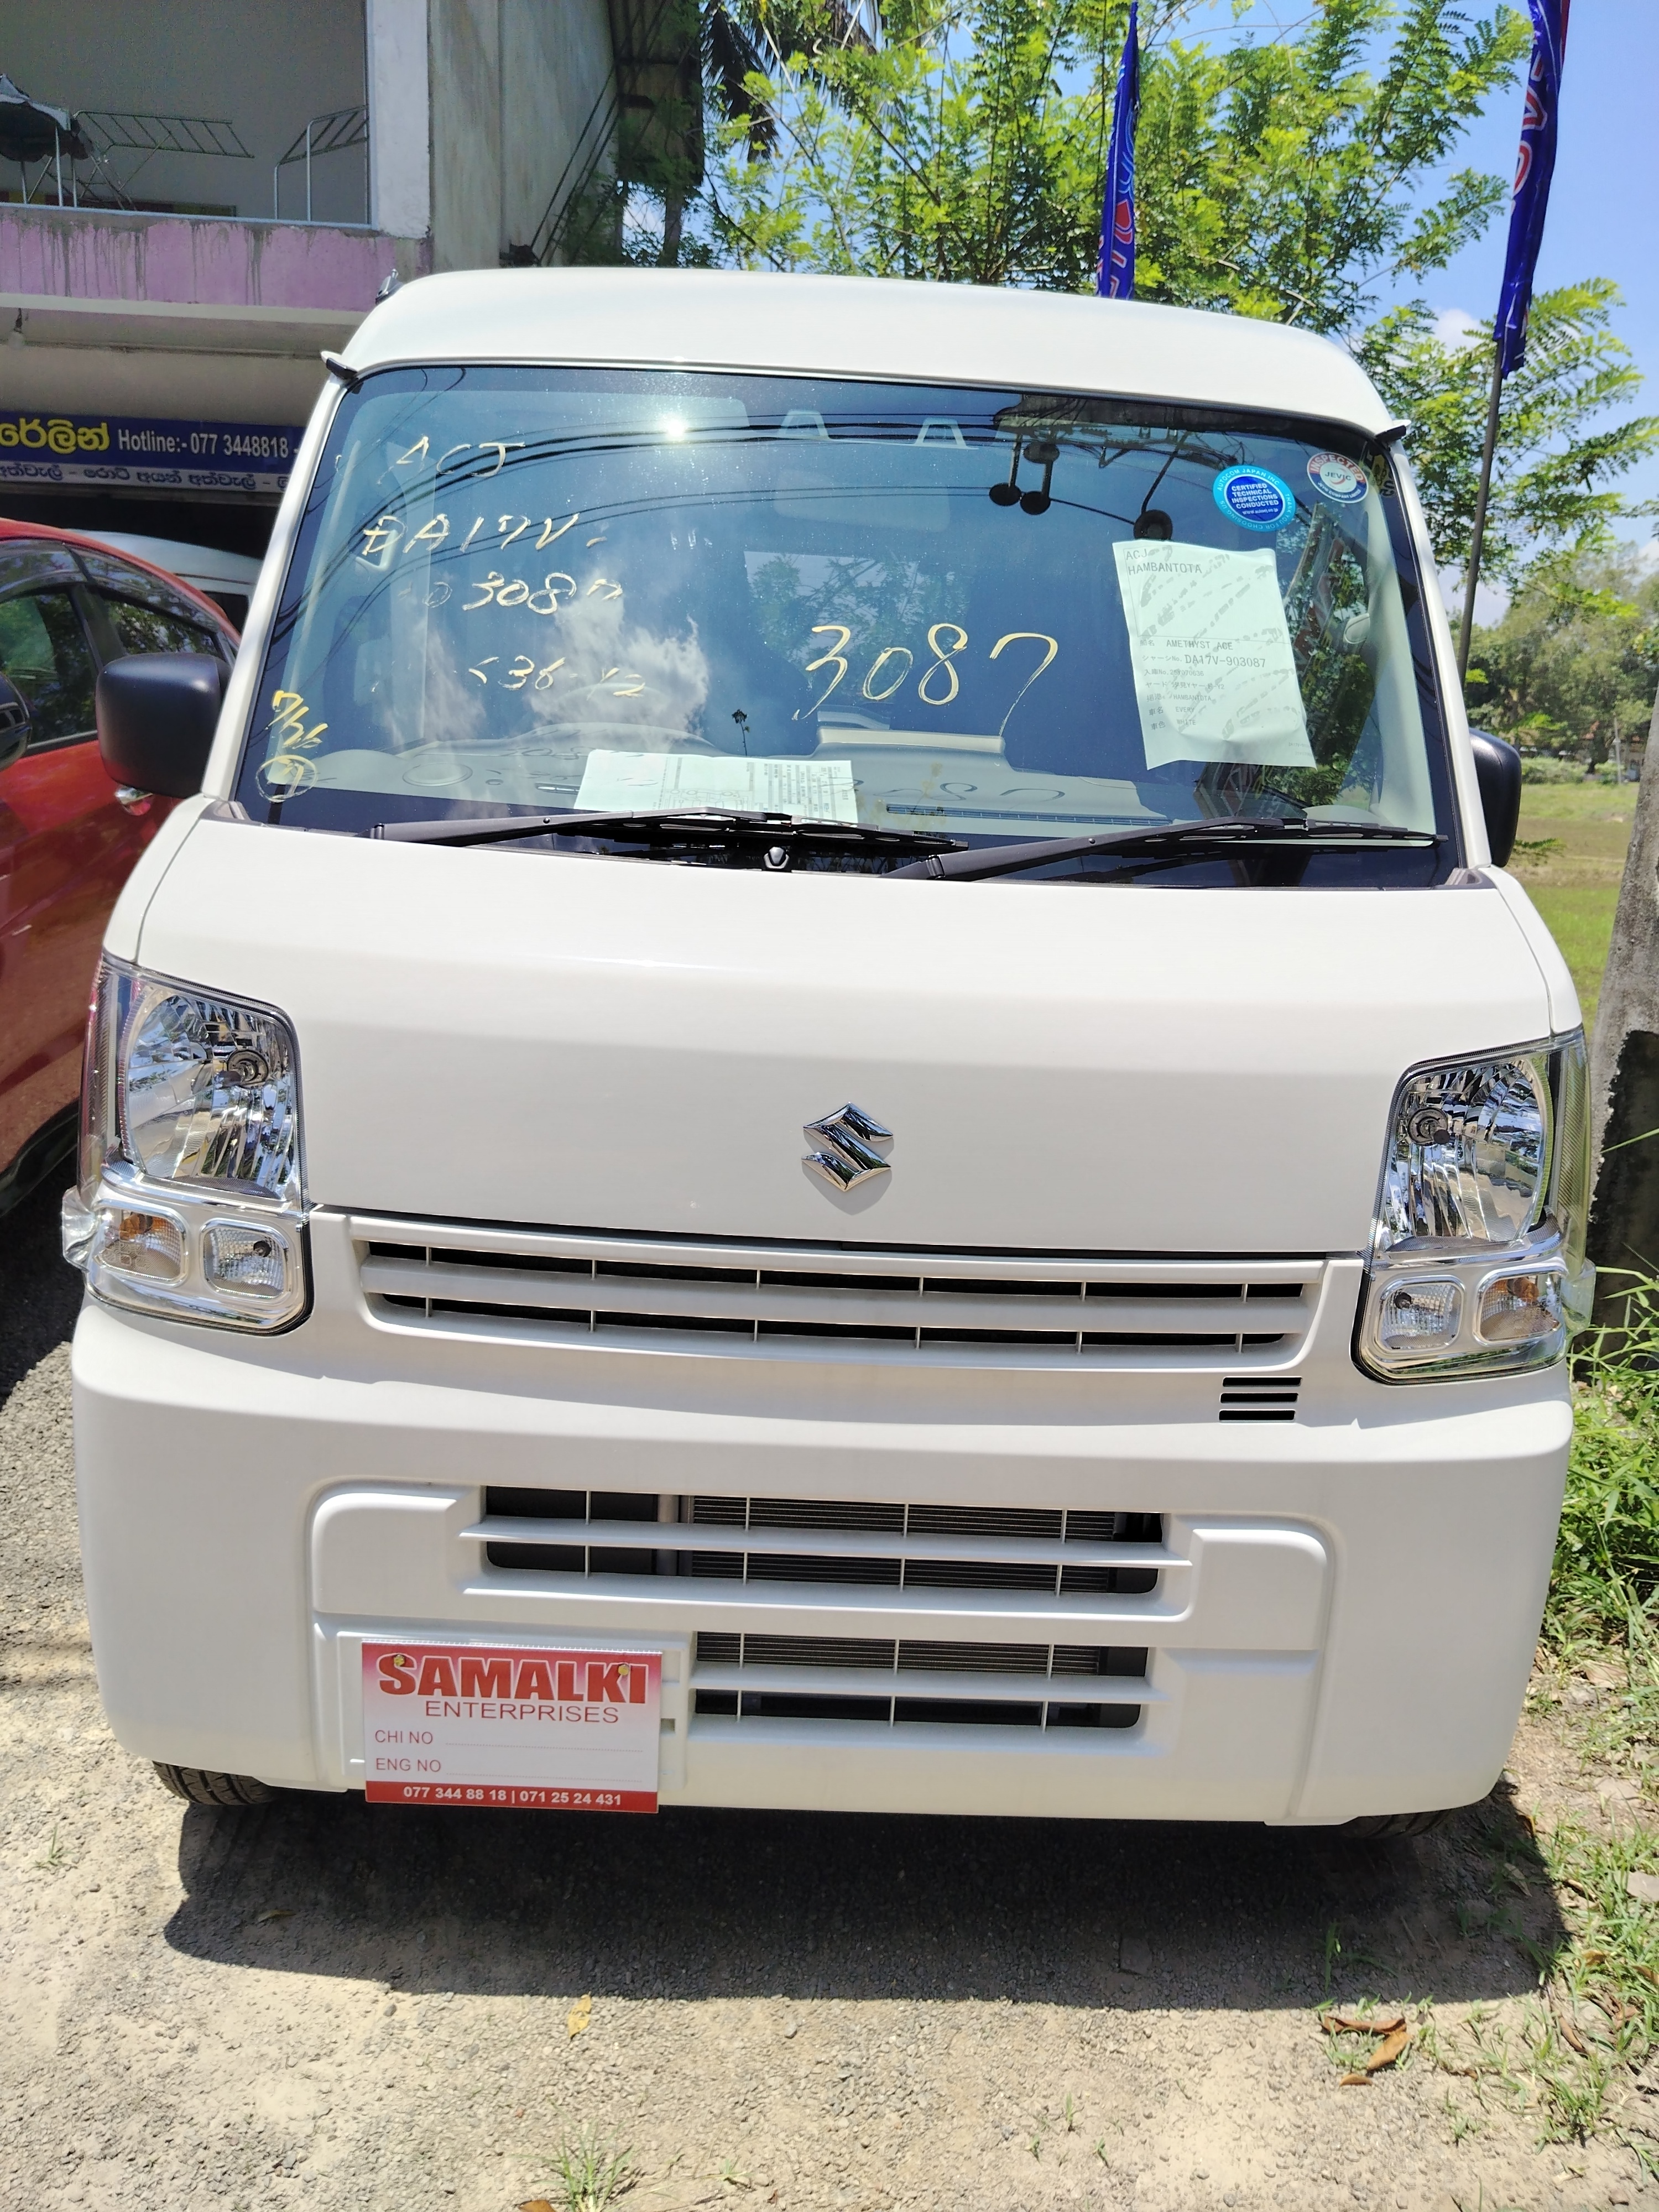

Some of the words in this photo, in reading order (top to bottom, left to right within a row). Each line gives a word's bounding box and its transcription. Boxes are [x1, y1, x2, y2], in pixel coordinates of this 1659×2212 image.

[190, 432, 218, 455] 077
[223, 434, 289, 458] 3448818
[1310, 453, 1364, 481] INSPECTED
[1217, 469, 1240, 492] AUTOCOM
[1242, 468, 1266, 477] JAPAN
[1267, 475, 1280, 486] INC
[1324, 472, 1352, 481] JEVIC
[1232, 483, 1267, 492] CERTIFIED
[1232, 489, 1272, 497] TECHNICAL
[1219, 500, 1228, 509] US
[1231, 494, 1278, 503] INSPECTIONS
[1236, 500, 1279, 509] CONDUCTED
[1226, 509, 1264, 529] CHOOSING
[1279, 514, 1290, 525] YOU
[1128, 562, 1203, 576] HAMBANTOTA
[1166, 639, 1211, 649] AMETHYST
[1217, 641, 1234, 650] ACE
[1184, 654, 1266, 668] DA17V-903087
[791, 623, 1058, 737] 3087
[1149, 706, 1164, 716] 車名
[1151, 721, 1166, 731] 車色
[376, 1652, 649, 1705] SAMALKI
[425, 1700, 619, 1724] ENTERPRISES
[374, 1729, 404, 1744] CHI
[409, 1730, 434, 1745] NO
[376, 1758, 411, 1772] ENG
[417, 1759, 441, 1773] NO
[403, 1786, 430, 1799] 077
[435, 1787, 462, 1800] 344
[466, 1788, 483, 1800] 88
[489, 1790, 507, 1801] 18
[519, 1791, 546, 1803] 071
[551, 1792, 570, 1804] 25
[573, 1792, 592, 1804] 24
[596, 1793, 622, 1806] 431
